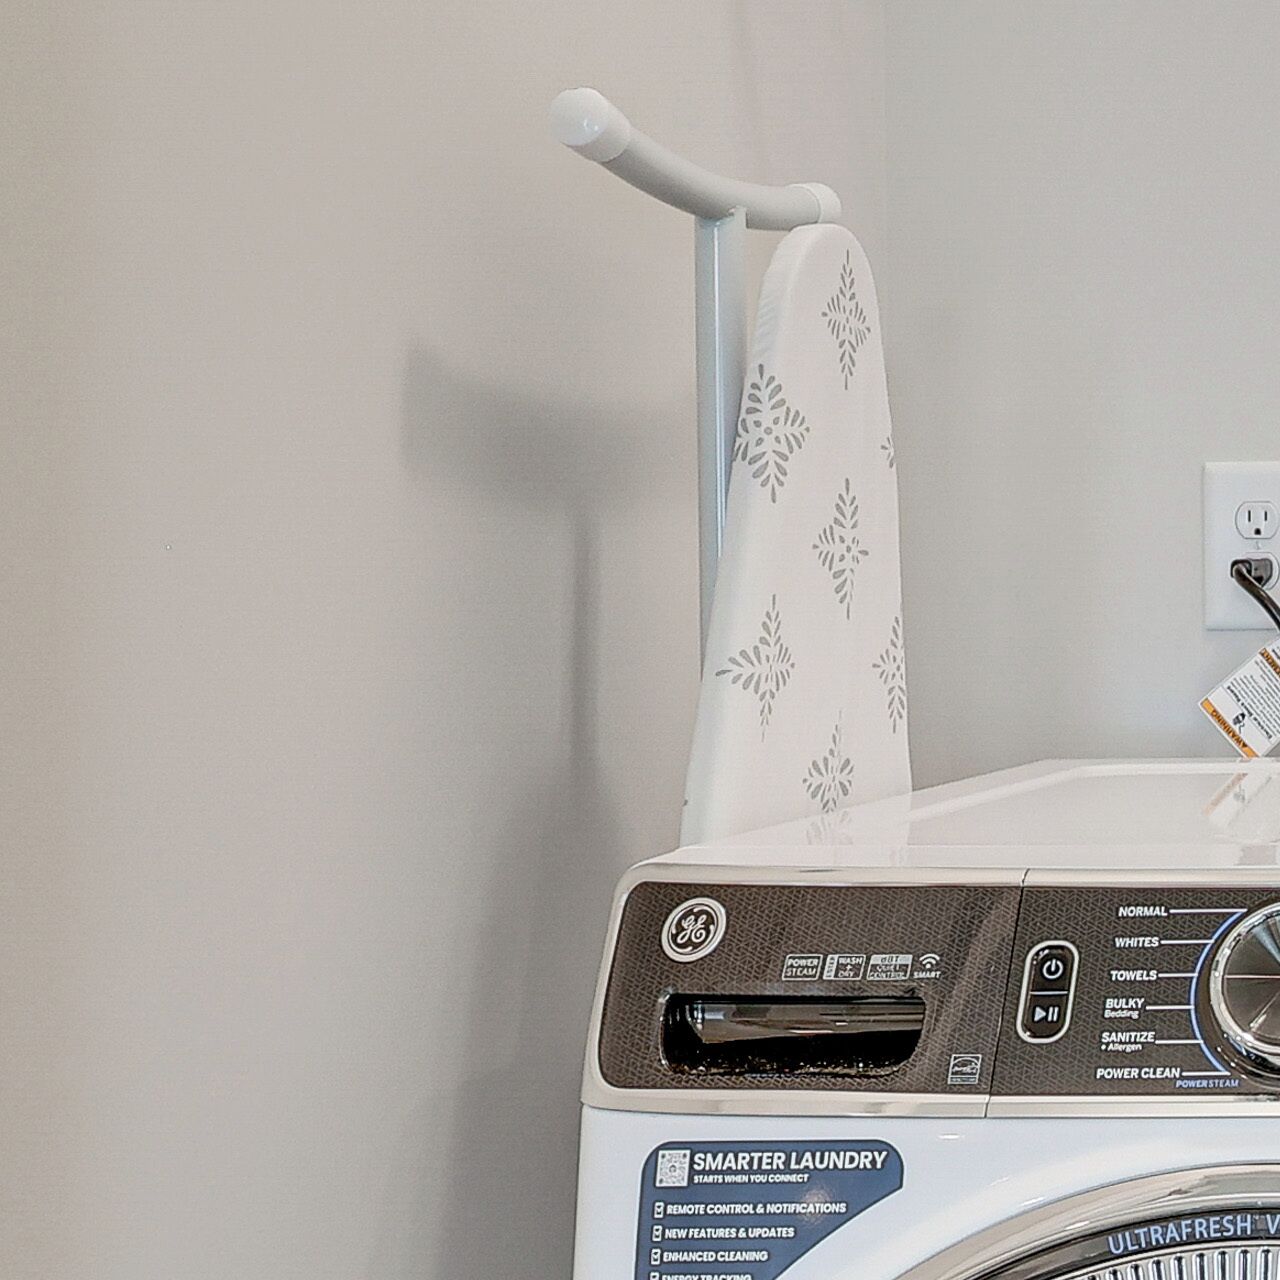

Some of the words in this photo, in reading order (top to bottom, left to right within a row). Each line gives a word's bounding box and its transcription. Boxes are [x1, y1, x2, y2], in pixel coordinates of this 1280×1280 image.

[1118, 906, 1168, 917] NORMAL
[1114, 937, 1160, 947] WHITES
[787, 958, 819, 967] POWER
[838, 957, 863, 965] WASH
[785, 968, 817, 977] STEAM
[913, 971, 942, 979] SMART
[1110, 970, 1157, 981] TOWELS
[1105, 998, 1145, 1009] BULKY
[1101, 1032, 1156, 1043] SANITIZE
[1096, 1068, 1139, 1079] POWER
[1141, 1068, 1181, 1078] CLEAN
[693, 1151, 786, 1170] SMARTER
[789, 1151, 887, 1169] LAUNDRY
[693, 1175, 723, 1184] STARTS
[724, 1174, 749, 1183] WHEN
[750, 1174, 768, 1183] YOU
[768, 1173, 809, 1183] CONNECT
[666, 1204, 705, 1215] REMOTE
[706, 1203, 755, 1215] CONTROL
[756, 1203, 765, 1214] &
[766, 1202, 847, 1214] NOTIFICATIONS
[664, 1228, 688, 1239] NEW
[688, 1228, 737, 1239] FEATURES
[738, 1227, 747, 1238] &
[748, 1227, 795, 1238] UPDATES
[1108, 1213, 1251, 1255] ULTRAFRESH
[662, 1251, 716, 1262] ENHANCED
[716, 1251, 769, 1262] CLEANING
